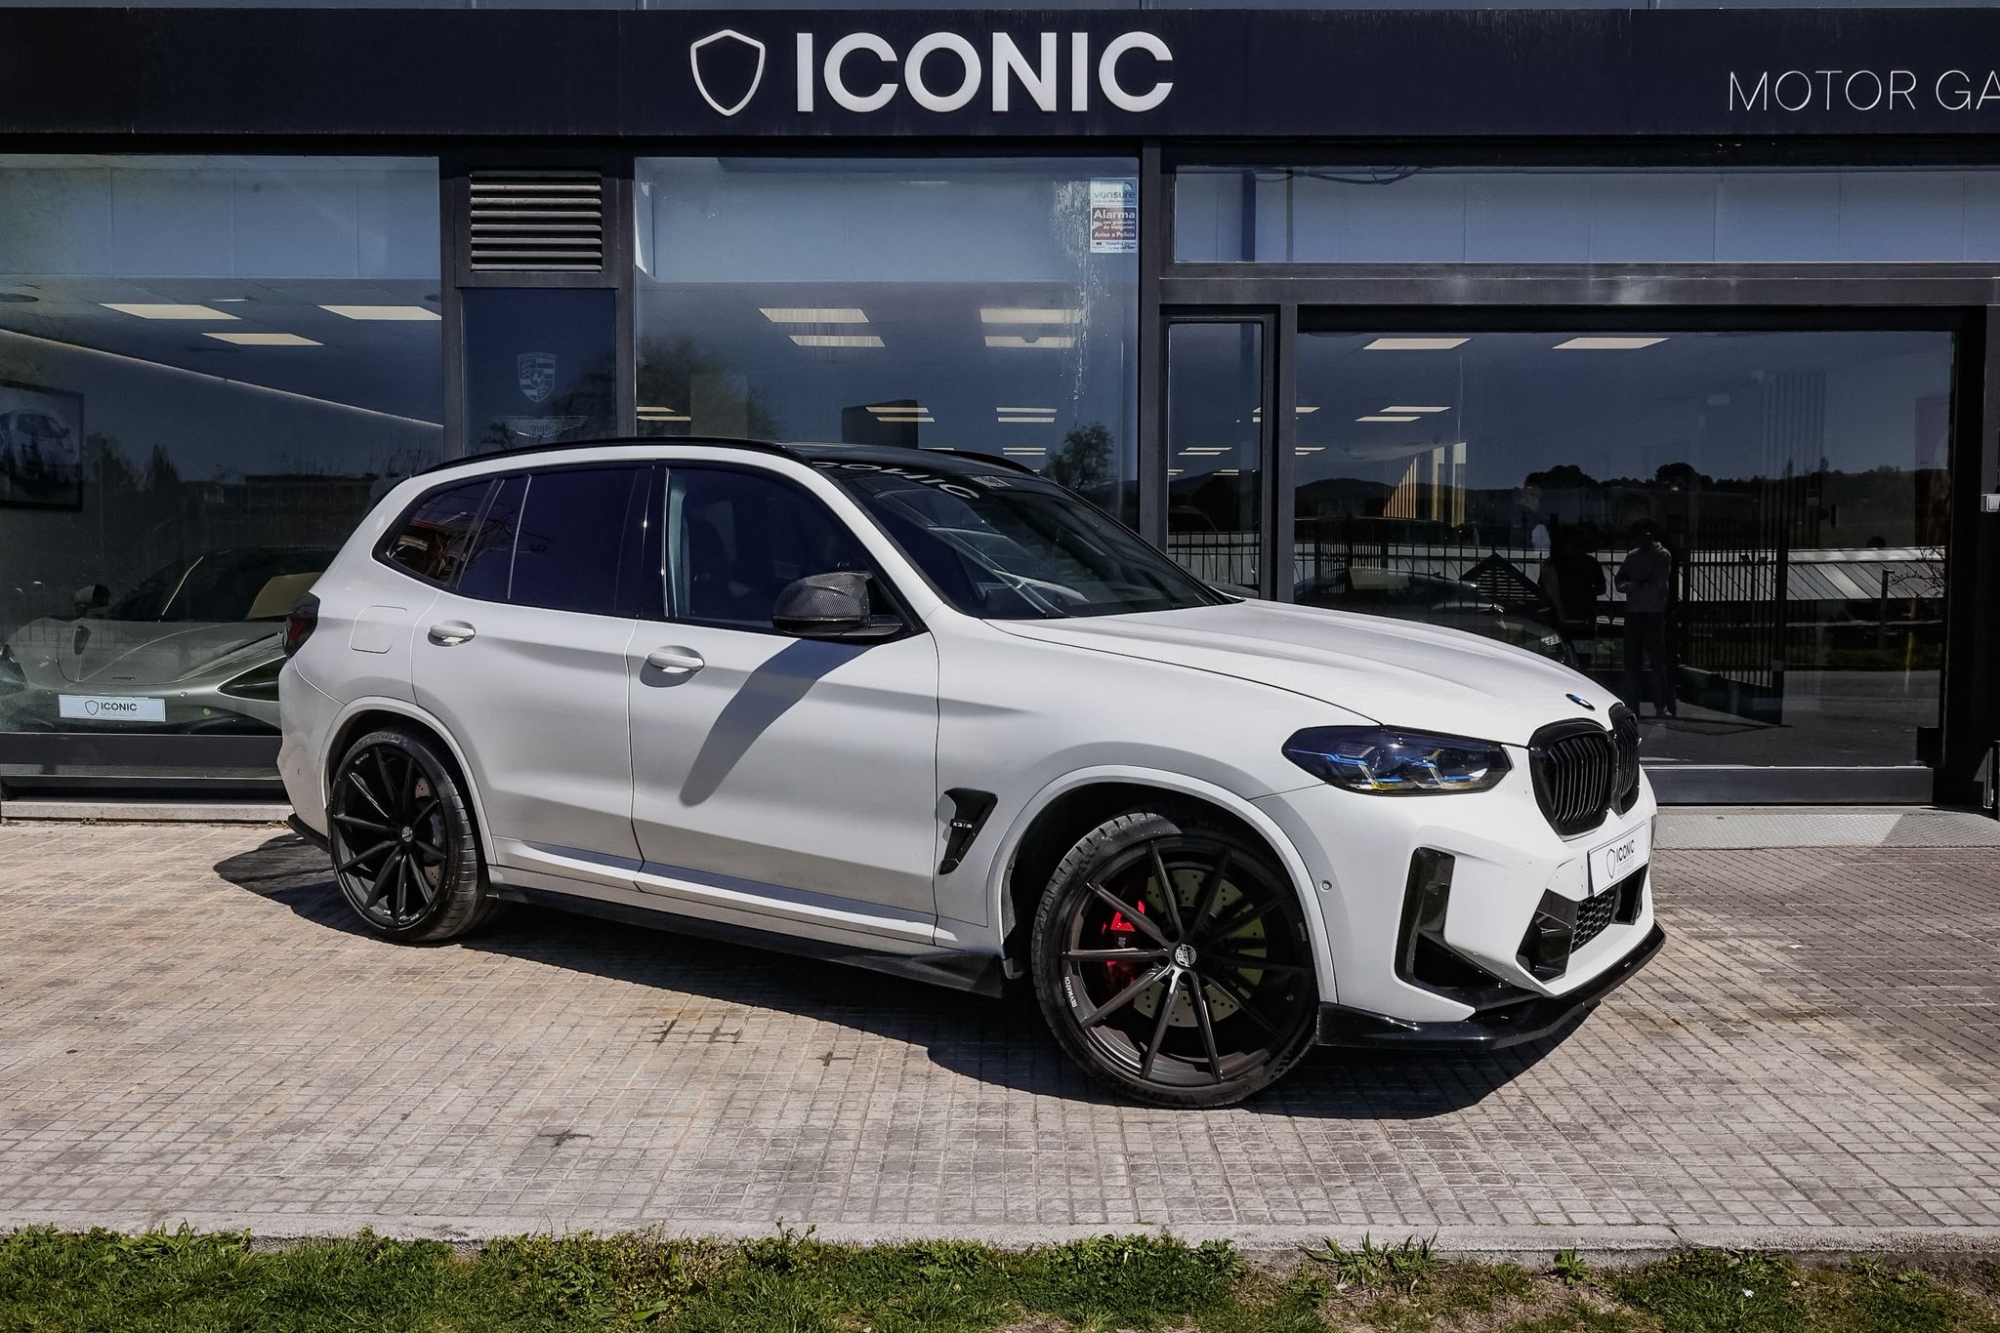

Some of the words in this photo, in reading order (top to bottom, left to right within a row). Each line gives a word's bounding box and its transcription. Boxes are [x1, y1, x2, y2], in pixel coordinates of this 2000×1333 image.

[797, 31, 1174, 112] ICONIC
[1729, 70, 1916, 111] MOTOR
[1935, 70, 2000, 110] GA
[1093, 209, 1135, 219] Alarma
[101, 702, 137, 712] ICONIC
[1616, 839, 1635, 863] ICONIC
